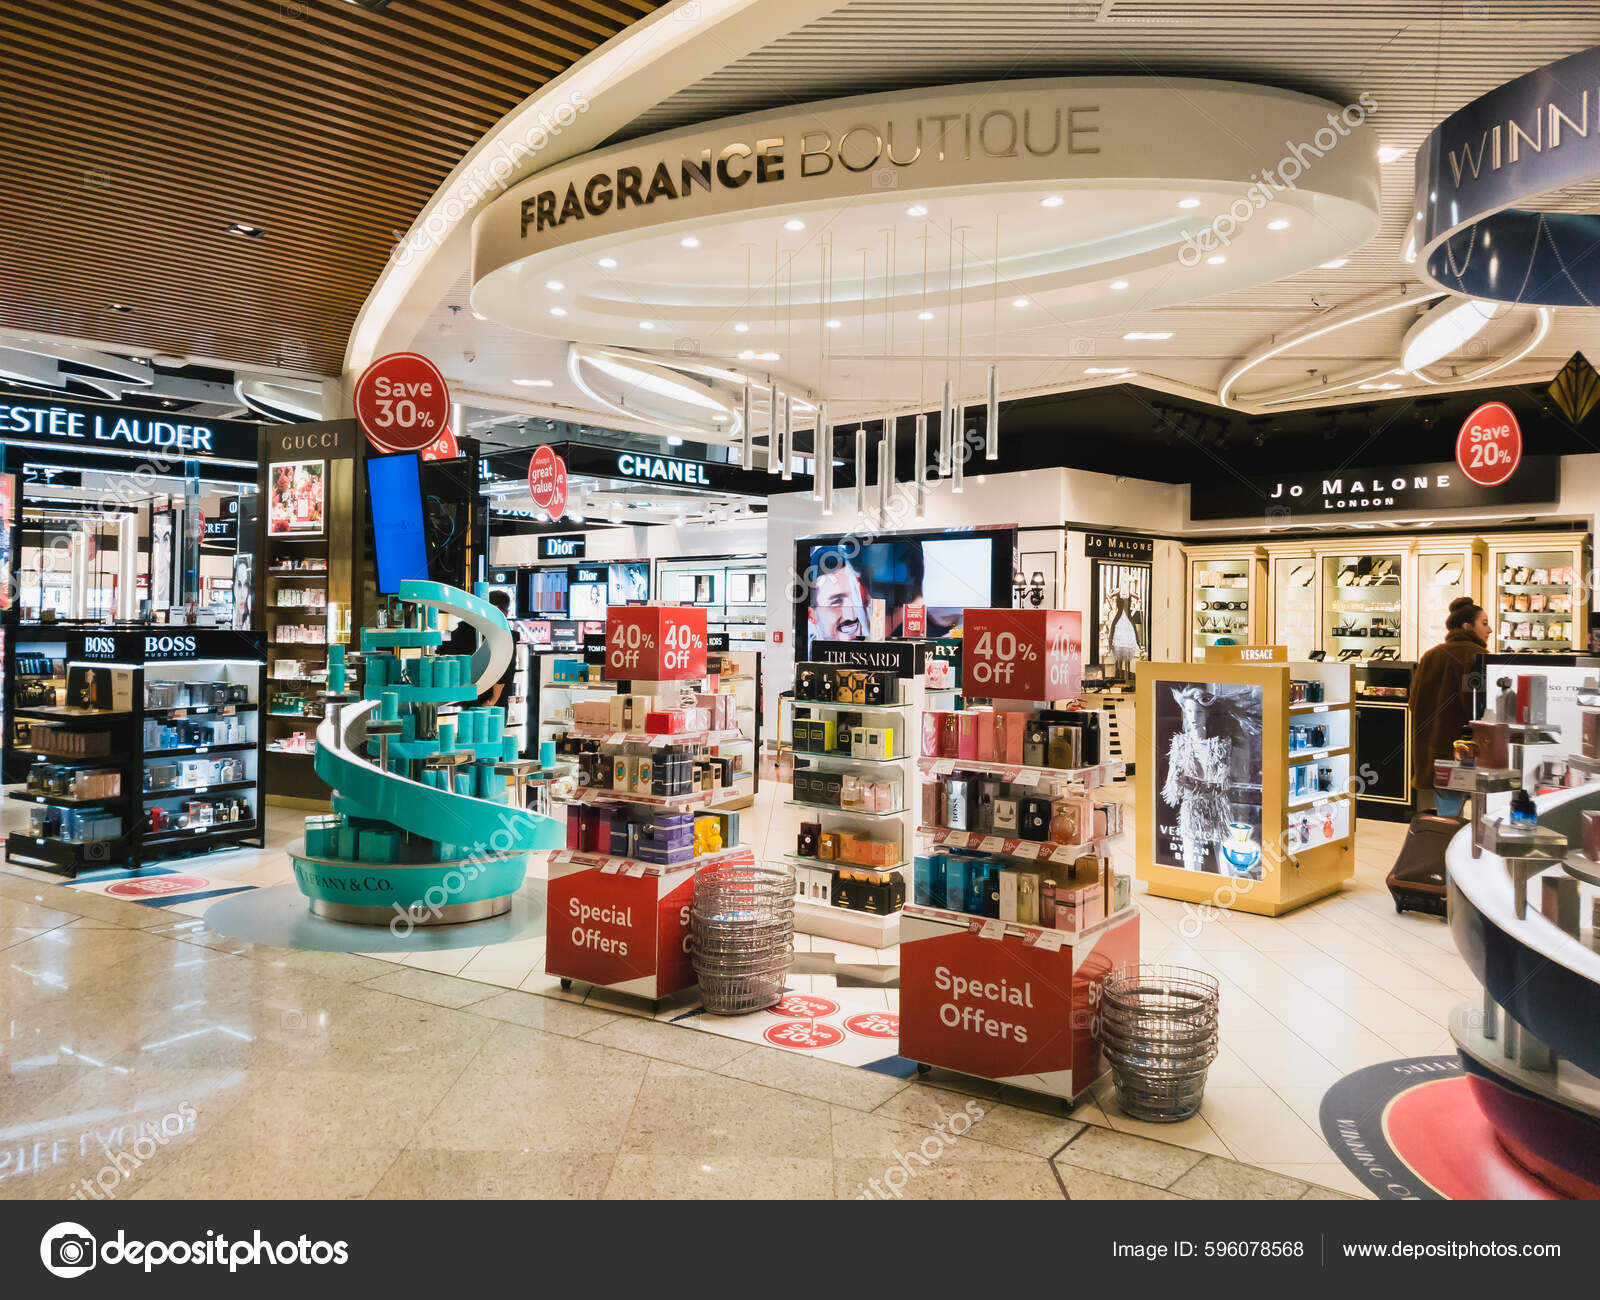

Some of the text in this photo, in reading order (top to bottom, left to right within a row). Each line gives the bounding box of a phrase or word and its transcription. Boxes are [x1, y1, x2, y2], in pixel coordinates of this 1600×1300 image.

[520, 105, 1100, 238] FRAGRANCE BOUTIQUE
[374, 376, 433, 398] Save
[374, 400, 435, 428] 30%
[95, 415, 213, 450] LAUDER
[282, 432, 338, 450] GUCCI
[1470, 425, 1510, 443] Save
[1470, 442, 1511, 468] 20%
[532, 465, 553, 483] great
[618, 454, 710, 485] CHANEL
[532, 480, 553, 494] value
[1322, 475, 1450, 494] MALONE
[1324, 498, 1394, 509] LONDON
[203, 523, 229, 534] CRET
[547, 538, 575, 556] Dior
[1108, 538, 1152, 551] MALONE
[578, 570, 598, 582] Dior
[85, 637, 115, 653] BOSS
[144, 636, 196, 652] BOSS
[611, 624, 655, 649] 40%
[664, 624, 703, 650] 40%
[973, 632, 1037, 661] 40%
[1050, 633, 1078, 661] 40%
[1241, 649, 1273, 661] VERSACE
[611, 650, 639, 668] Off
[664, 651, 690, 669] Off
[824, 650, 900, 668] TRUSSARDI
[973, 662, 1015, 684] Off
[1050, 664, 1069, 685] Off
[349, 878, 361, 892] &
[569, 897, 632, 928] Special
[571, 926, 628, 956] Offers
[935, 966, 1033, 1009] Special
[865, 1015, 899, 1027] Sav
[940, 1003, 1028, 1043] Offers
[774, 1029, 817, 1045] 20%
